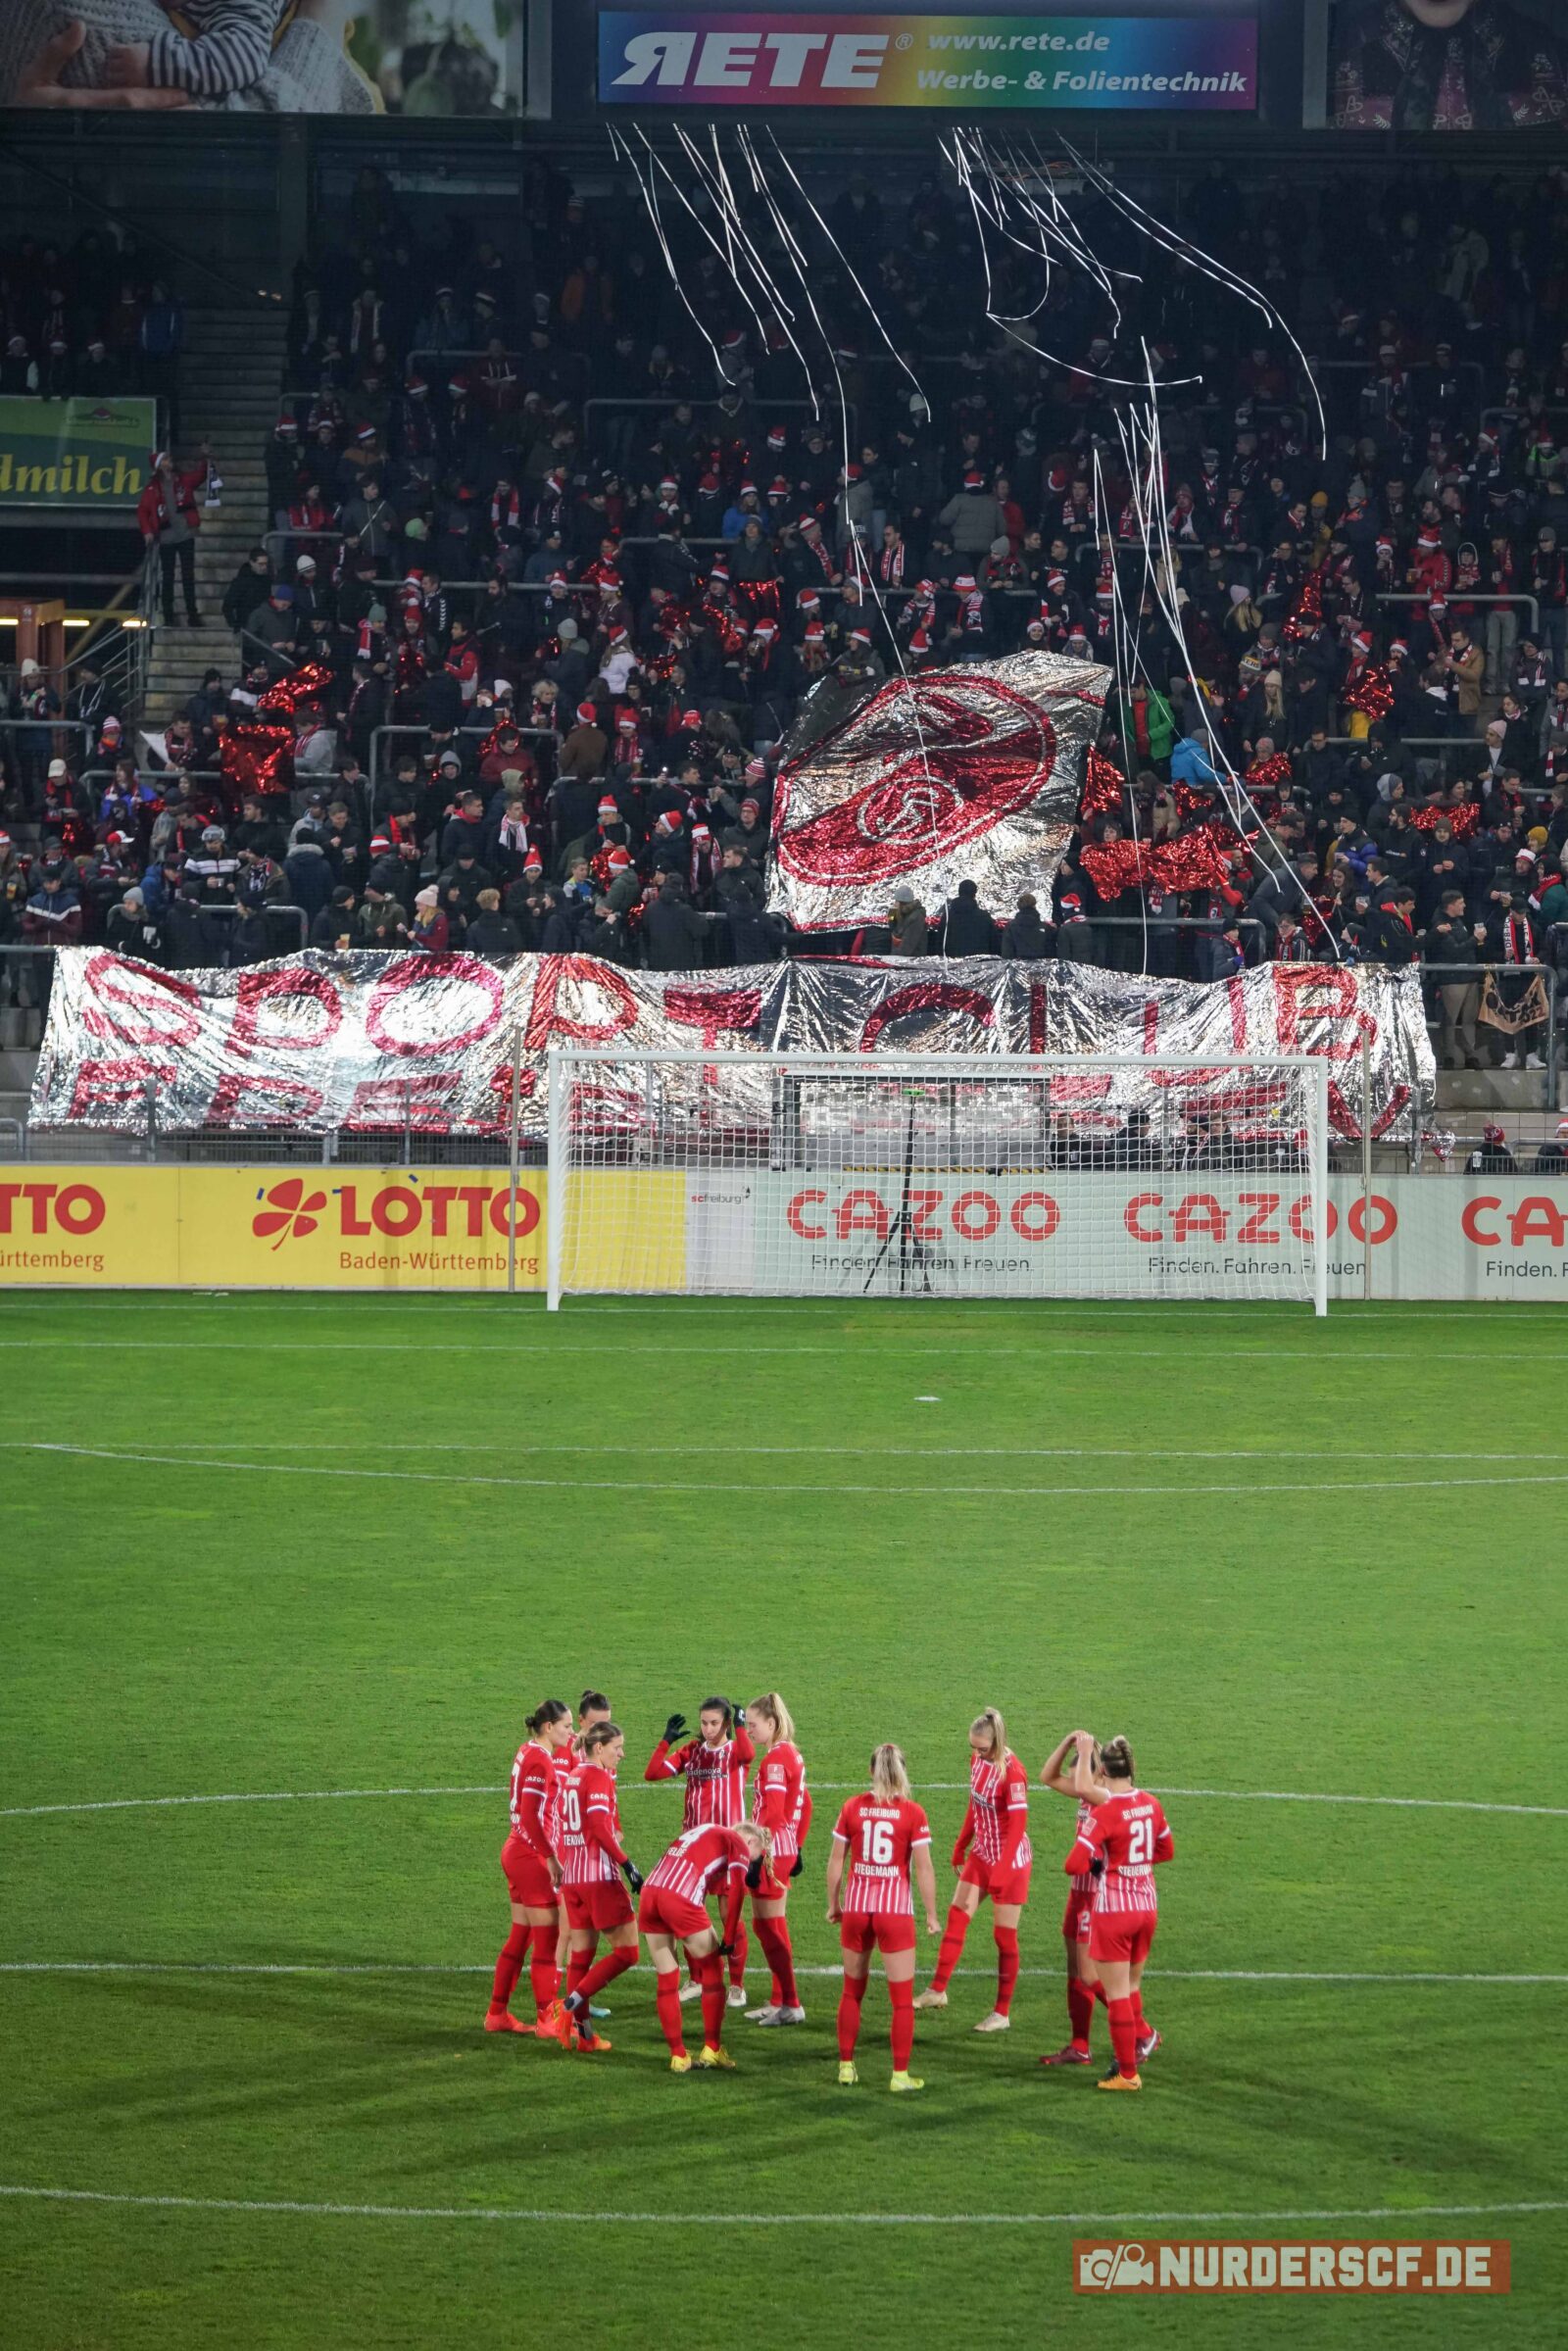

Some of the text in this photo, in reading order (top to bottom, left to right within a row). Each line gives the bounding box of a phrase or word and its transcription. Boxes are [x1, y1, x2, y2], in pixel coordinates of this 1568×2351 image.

[930, 31, 1110, 51] www.rete.de
[916, 70, 1247, 92] Werbe- & Folientechnik
[340, 1186, 541, 1238] LOTTO
[787, 1189, 1060, 1242] CAZOO
[1124, 1192, 1398, 1244] CAZOO
[1149, 1256, 1219, 1275] Finden.
[1224, 1257, 1297, 1275] Fahren.
[1487, 1260, 1558, 1277] Finden.
[862, 1820, 895, 1864] 16
[1129, 1818, 1152, 1864] 21
[854, 1862, 900, 1878] STEGEMANN
